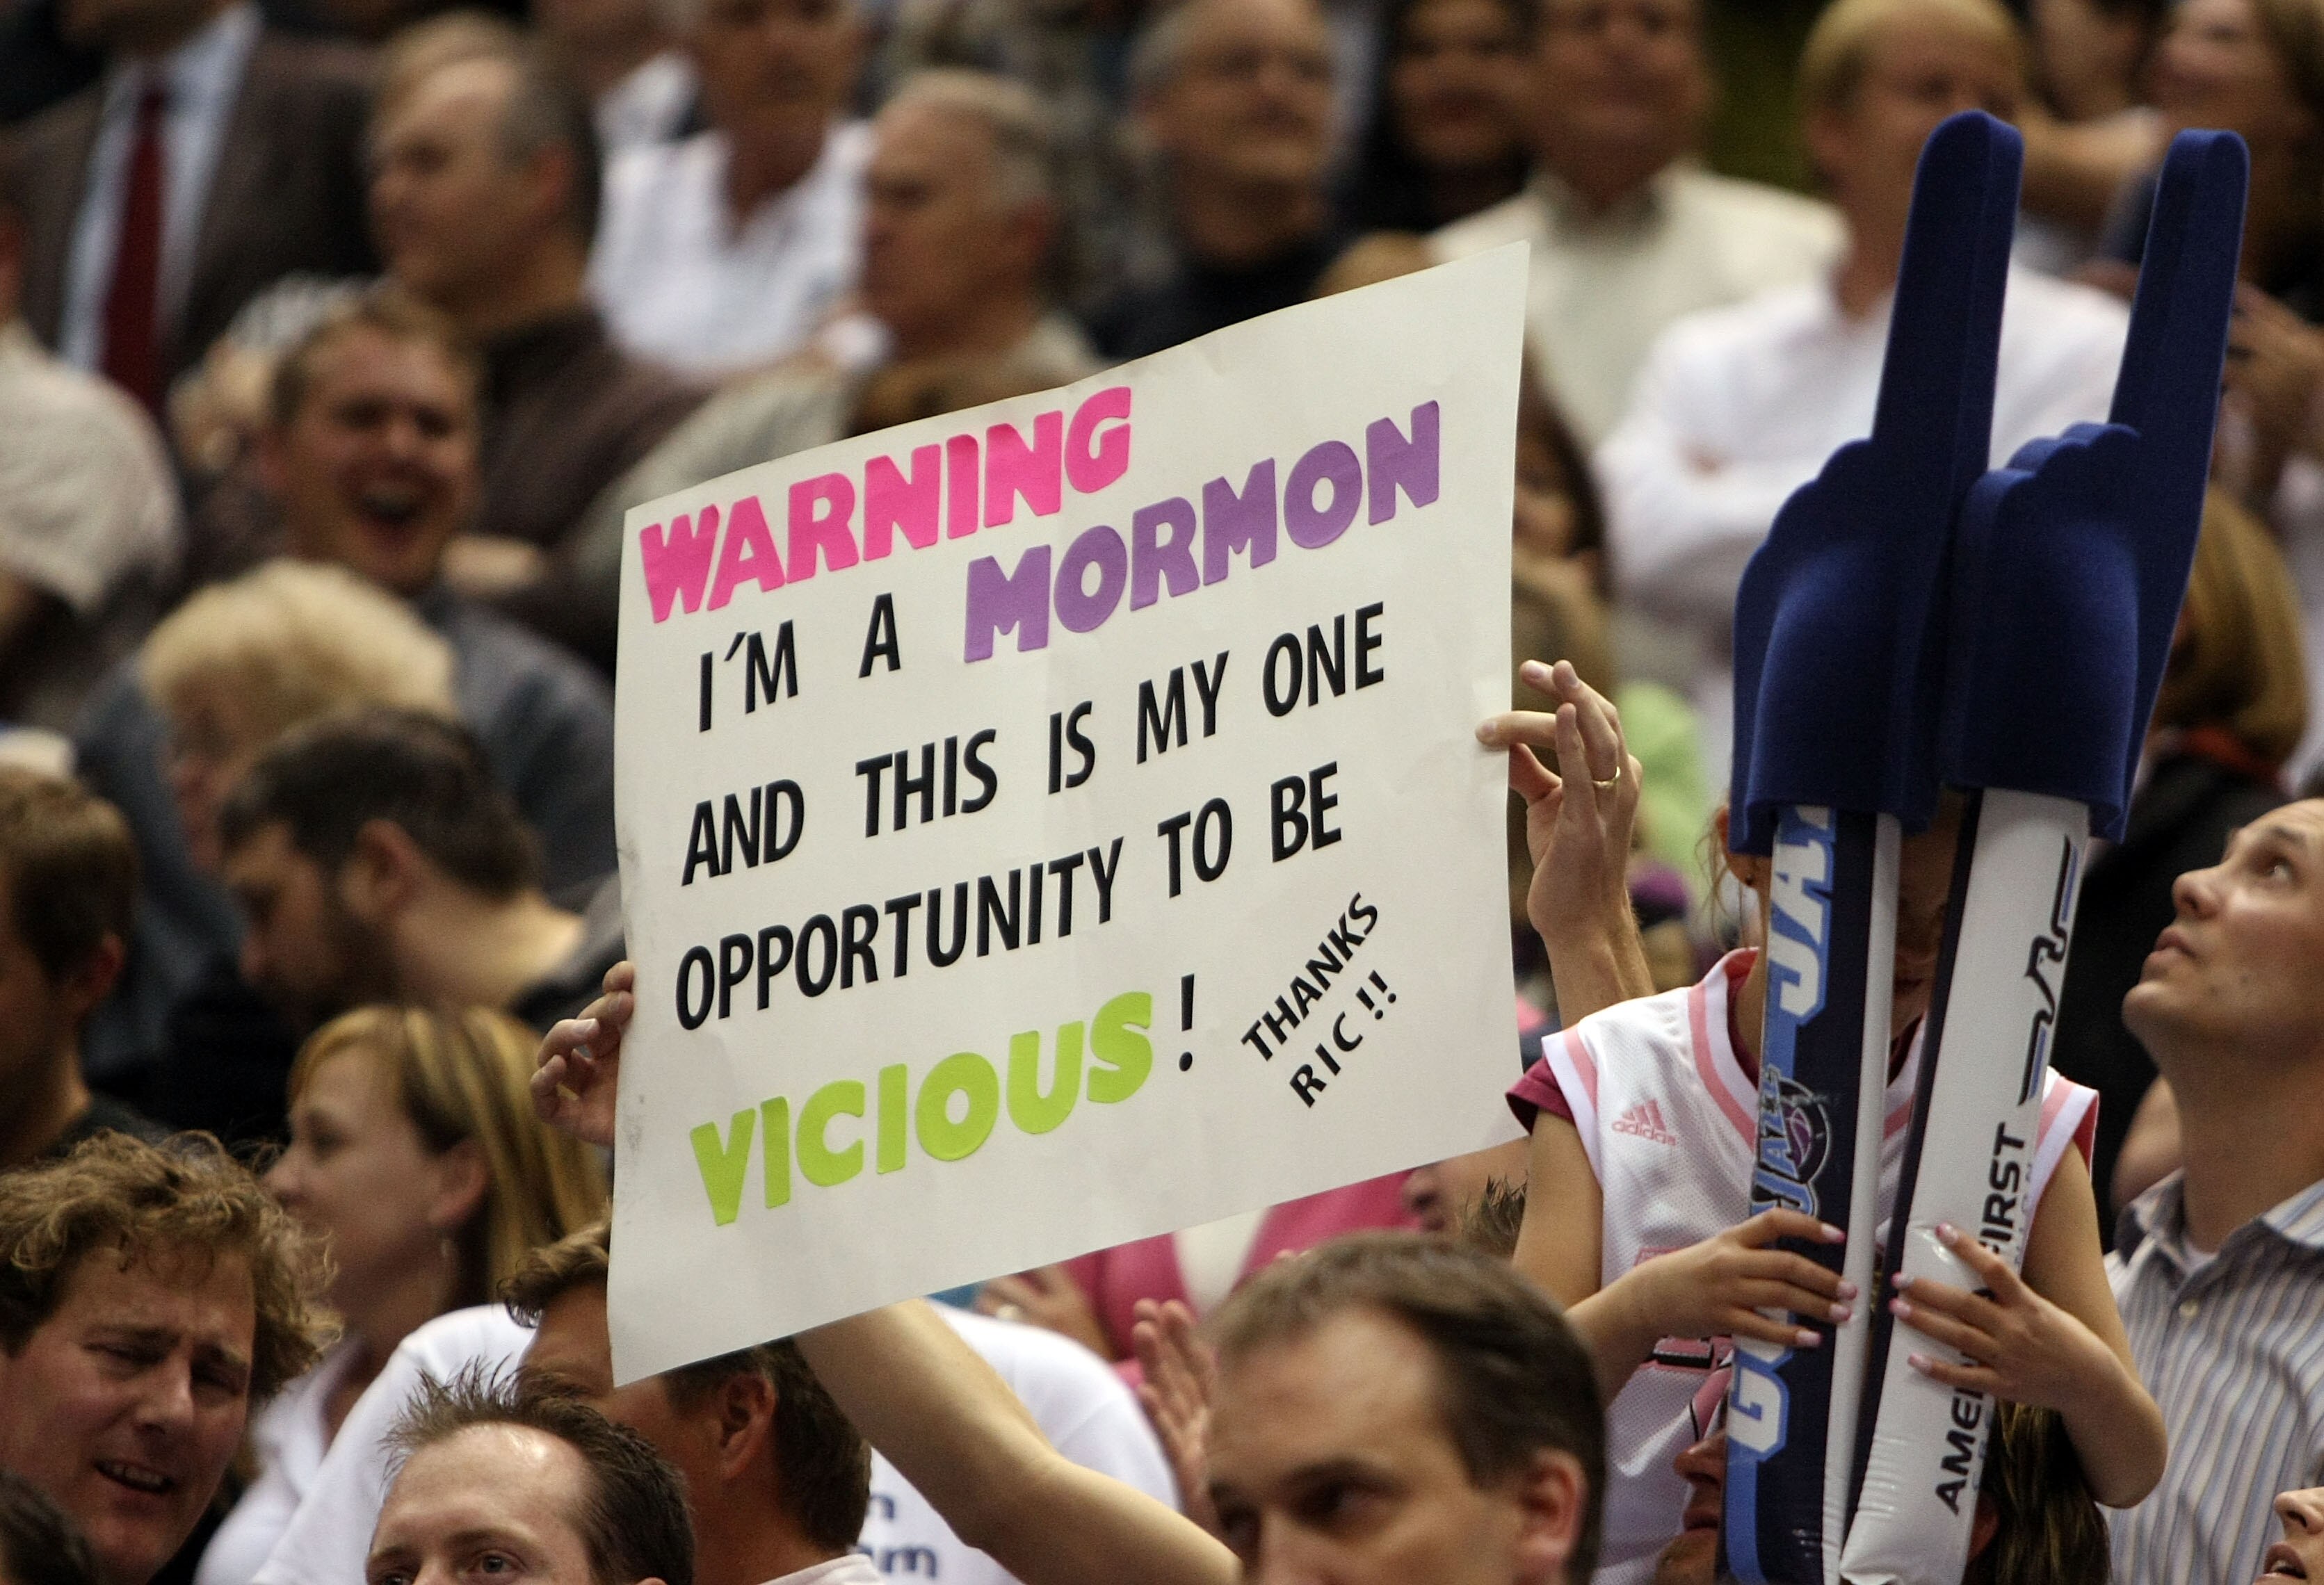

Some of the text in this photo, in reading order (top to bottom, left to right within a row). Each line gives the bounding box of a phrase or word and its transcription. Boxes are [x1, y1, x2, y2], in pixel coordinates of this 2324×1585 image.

[639, 386, 1132, 624] WARNING
[699, 400, 1440, 733] I'M A MORMON
[681, 601, 1384, 887] AND THIS IS MY ONE
[675, 761, 1342, 1031] OPPORTUNITY TO BE
[1241, 891, 1379, 1062] THANKS
[689, 991, 1154, 1227] VICIOUS
[1612, 1120, 1677, 1147] adidas
